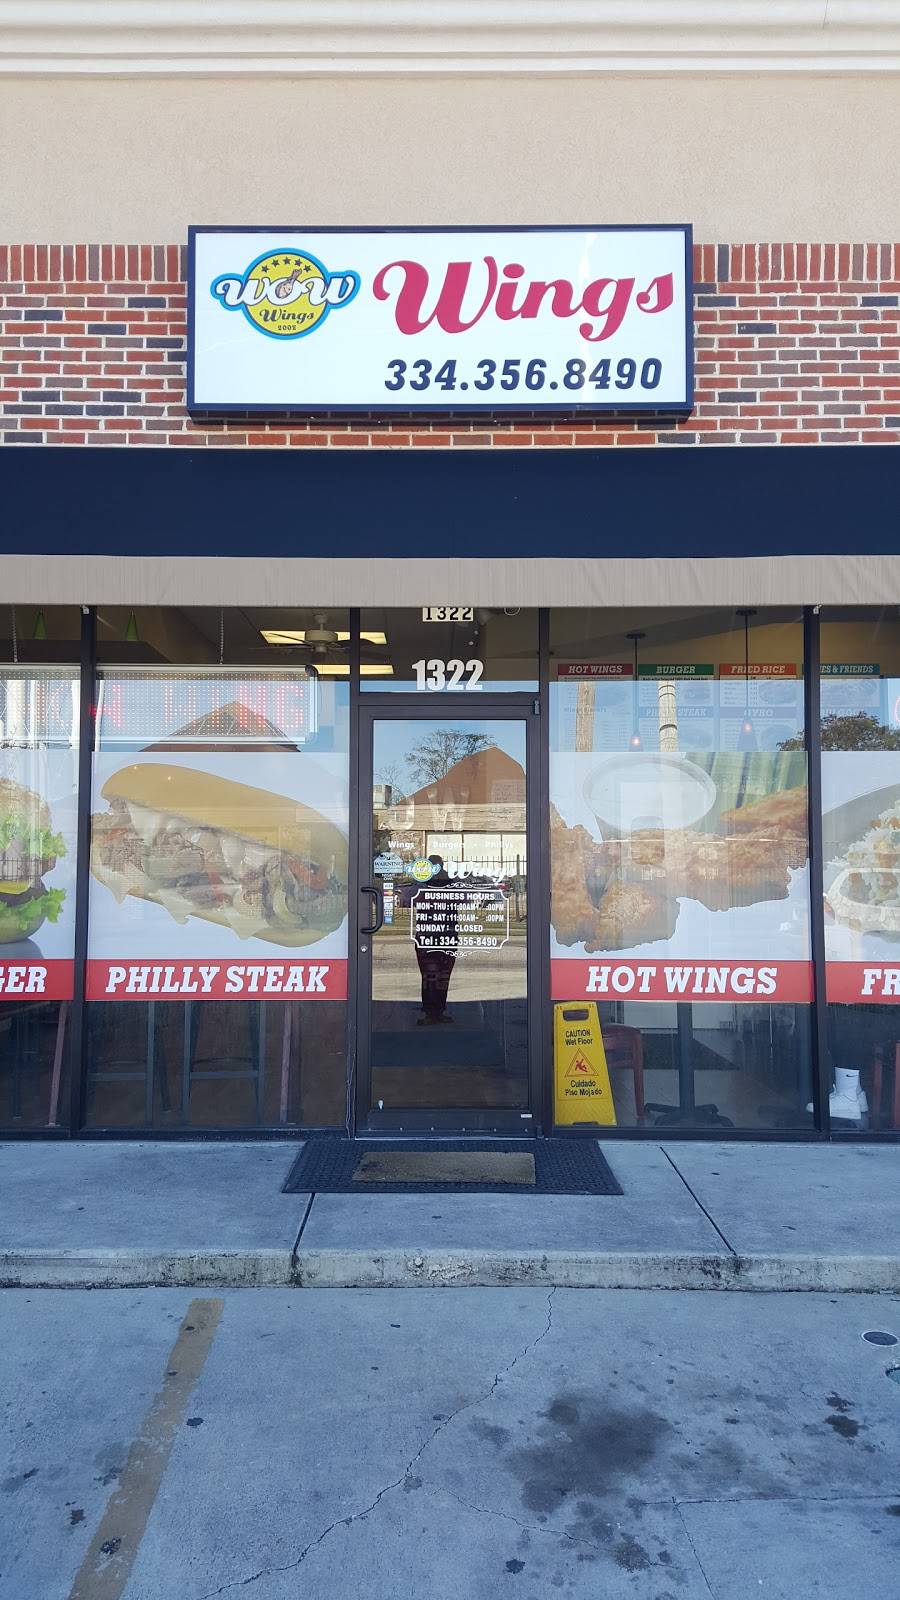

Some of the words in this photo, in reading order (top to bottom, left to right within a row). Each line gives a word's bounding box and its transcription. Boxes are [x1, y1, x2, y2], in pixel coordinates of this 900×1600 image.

[372, 255, 674, 342] Wings
[259, 309, 314, 324] Wings
[384, 358, 663, 391] 334.356.8490
[425, 607, 472, 620] 1322
[568, 665, 588, 673] HOT
[590, 665, 623, 673] WINGS
[656, 666, 696, 674] BURGER
[731, 665, 760, 674] FRIED
[763, 665, 786, 674] RICE
[832, 665, 839, 673] &
[840, 665, 874, 673] FRIENDS
[411, 659, 484, 691] 1322
[388, 840, 415, 850] Wings
[424, 892, 465, 900] BUSINESS
[467, 892, 495, 900] HOURS
[454, 924, 484, 932] CLOSED
[440, 936, 498, 946] 334-356-8490
[0, 966, 47, 993] ER
[105, 966, 220, 994] PHILLY
[224, 965, 330, 993] STEAK
[585, 966, 656, 993] HOT
[663, 966, 778, 995] WINGS
[861, 968, 900, 995] FR
[565, 1029, 591, 1038] CAUTION
[570, 1080, 597, 1088] Cuidado
[565, 1089, 578, 1097] Piso
[579, 1088, 603, 1097] Mojado
